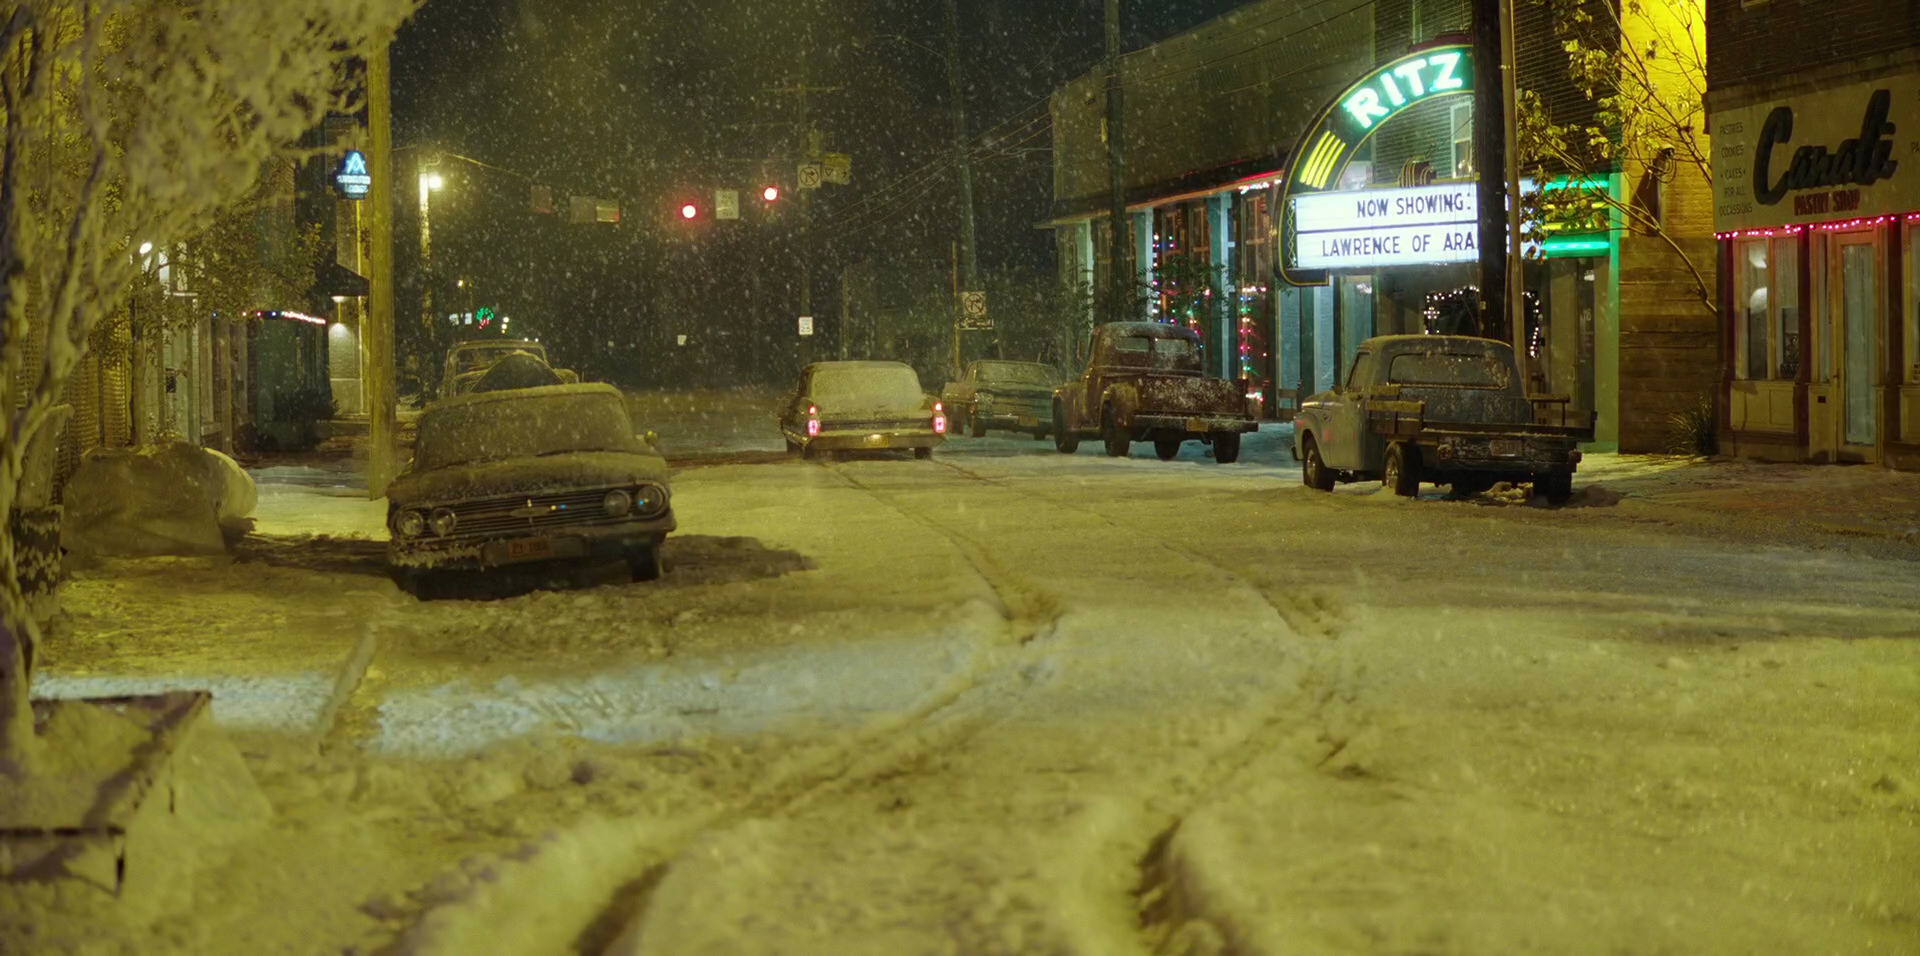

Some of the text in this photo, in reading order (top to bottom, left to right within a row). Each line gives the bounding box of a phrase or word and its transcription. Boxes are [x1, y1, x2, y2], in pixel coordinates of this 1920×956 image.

[1342, 51, 1463, 128] RITZ
[1357, 192, 1472, 218] NOW SHOWING:
[1794, 188, 1861, 216] PASTRY SHOP
[1322, 236, 1401, 257] LAWRENCE
[1412, 233, 1431, 252] OF
